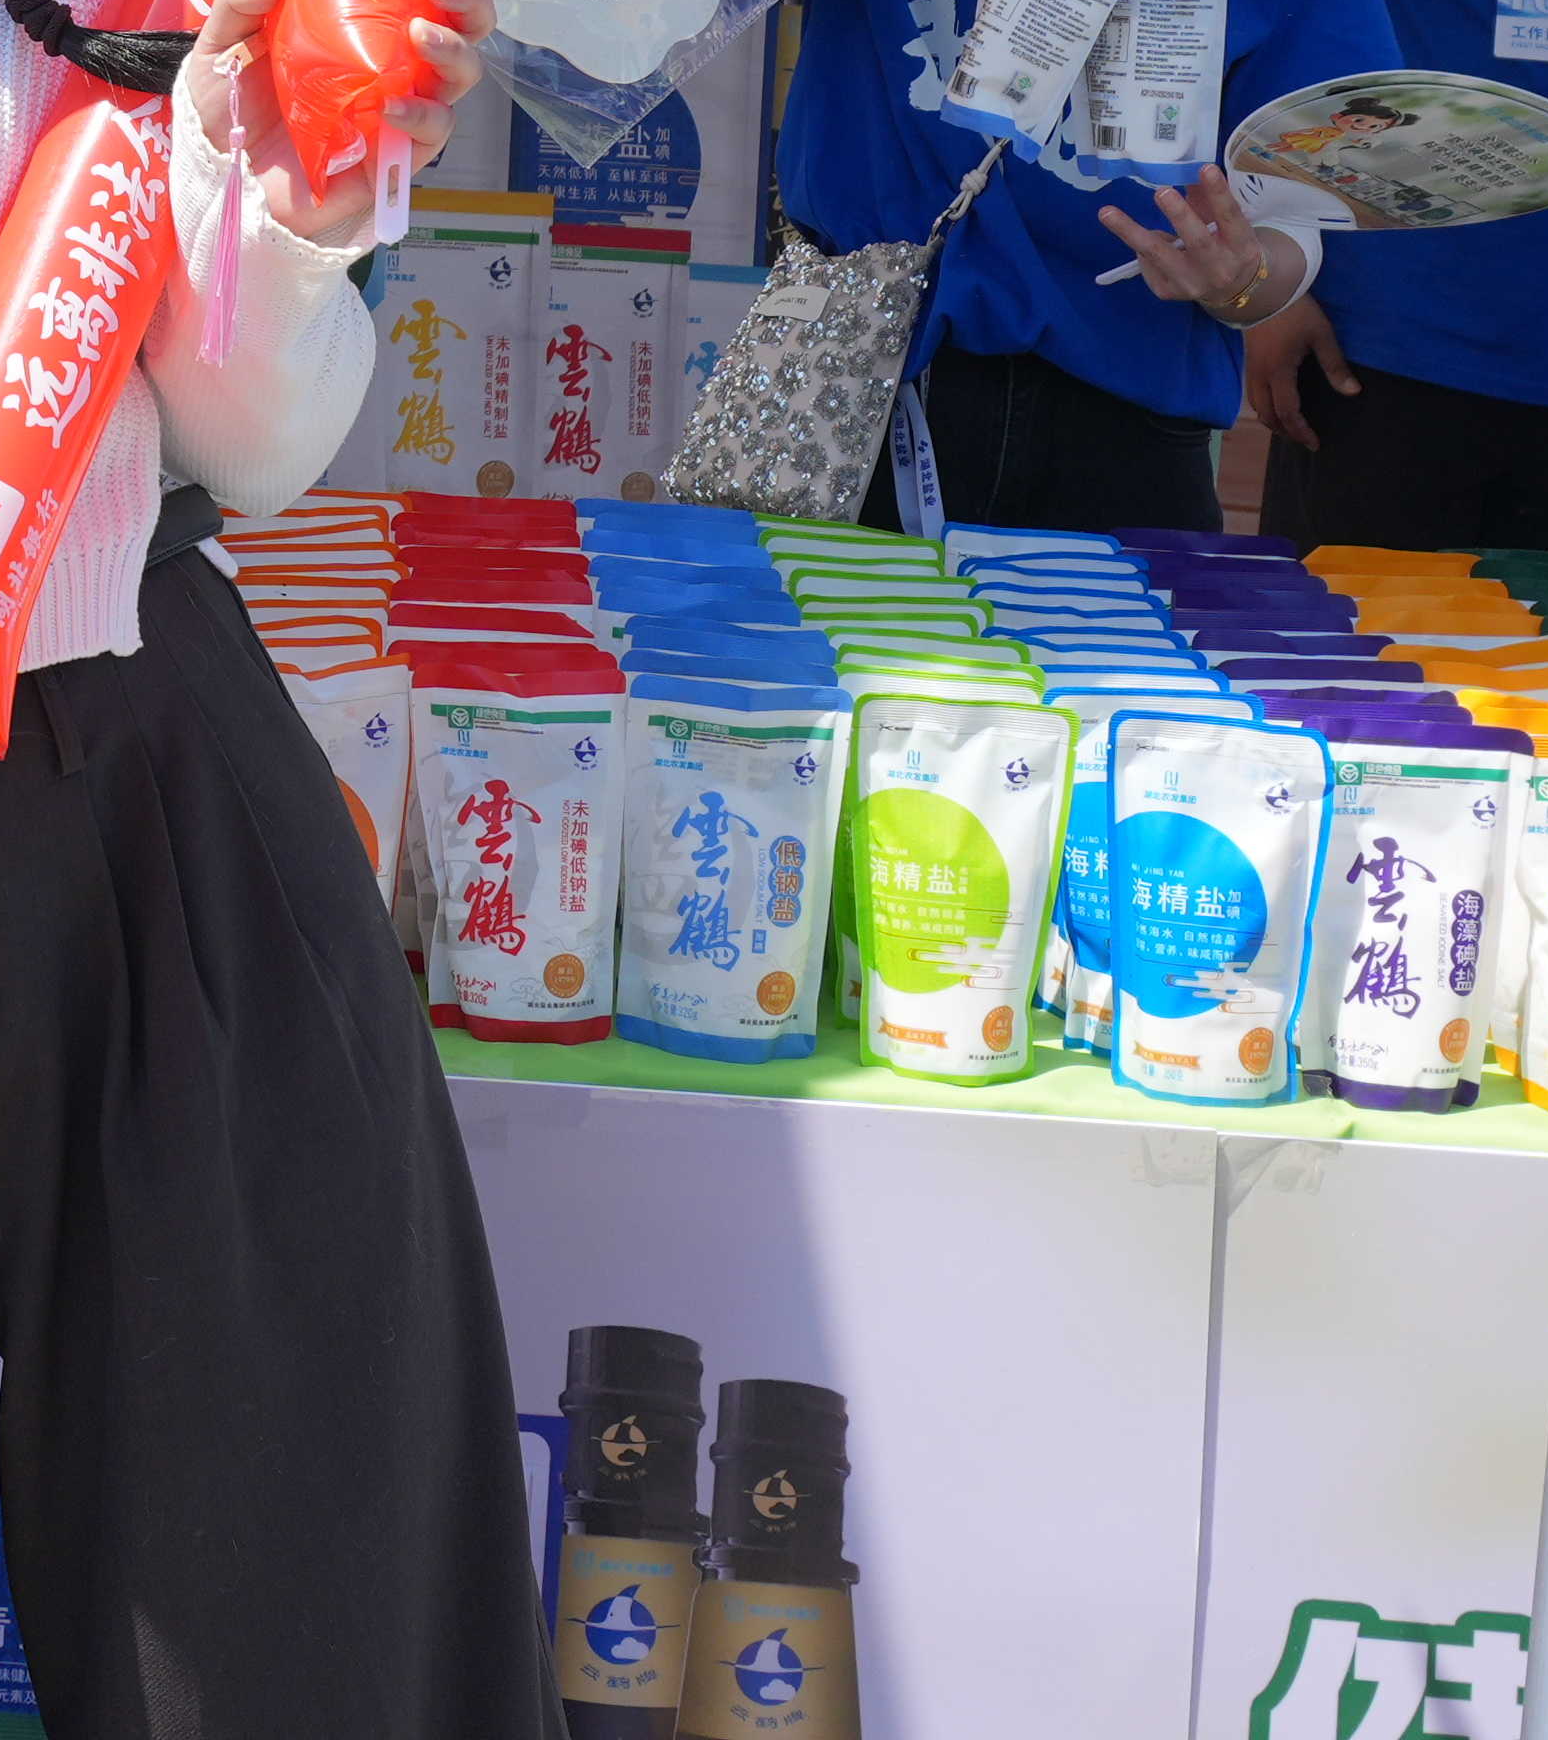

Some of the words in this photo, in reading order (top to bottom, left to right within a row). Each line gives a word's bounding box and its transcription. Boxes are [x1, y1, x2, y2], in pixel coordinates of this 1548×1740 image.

[537, 163, 598, 181] 天然低钠
[608, 168, 669, 185] 至鲜至纯
[607, 187, 668, 204] 从盐开始
[493, 335, 511, 440] 未加碘精制盐
[636, 340, 653, 437] 未加碘低钠盐
[569, 799, 591, 914] 未加碘低钠盐
[771, 840, 802, 924] 低钠盐
[870, 857, 959, 897] 海精盐
[1131, 877, 1227, 920] 海精盐
[1226, 888, 1243, 921] 加碘
[1454, 892, 1483, 993] 海藻碘盐
